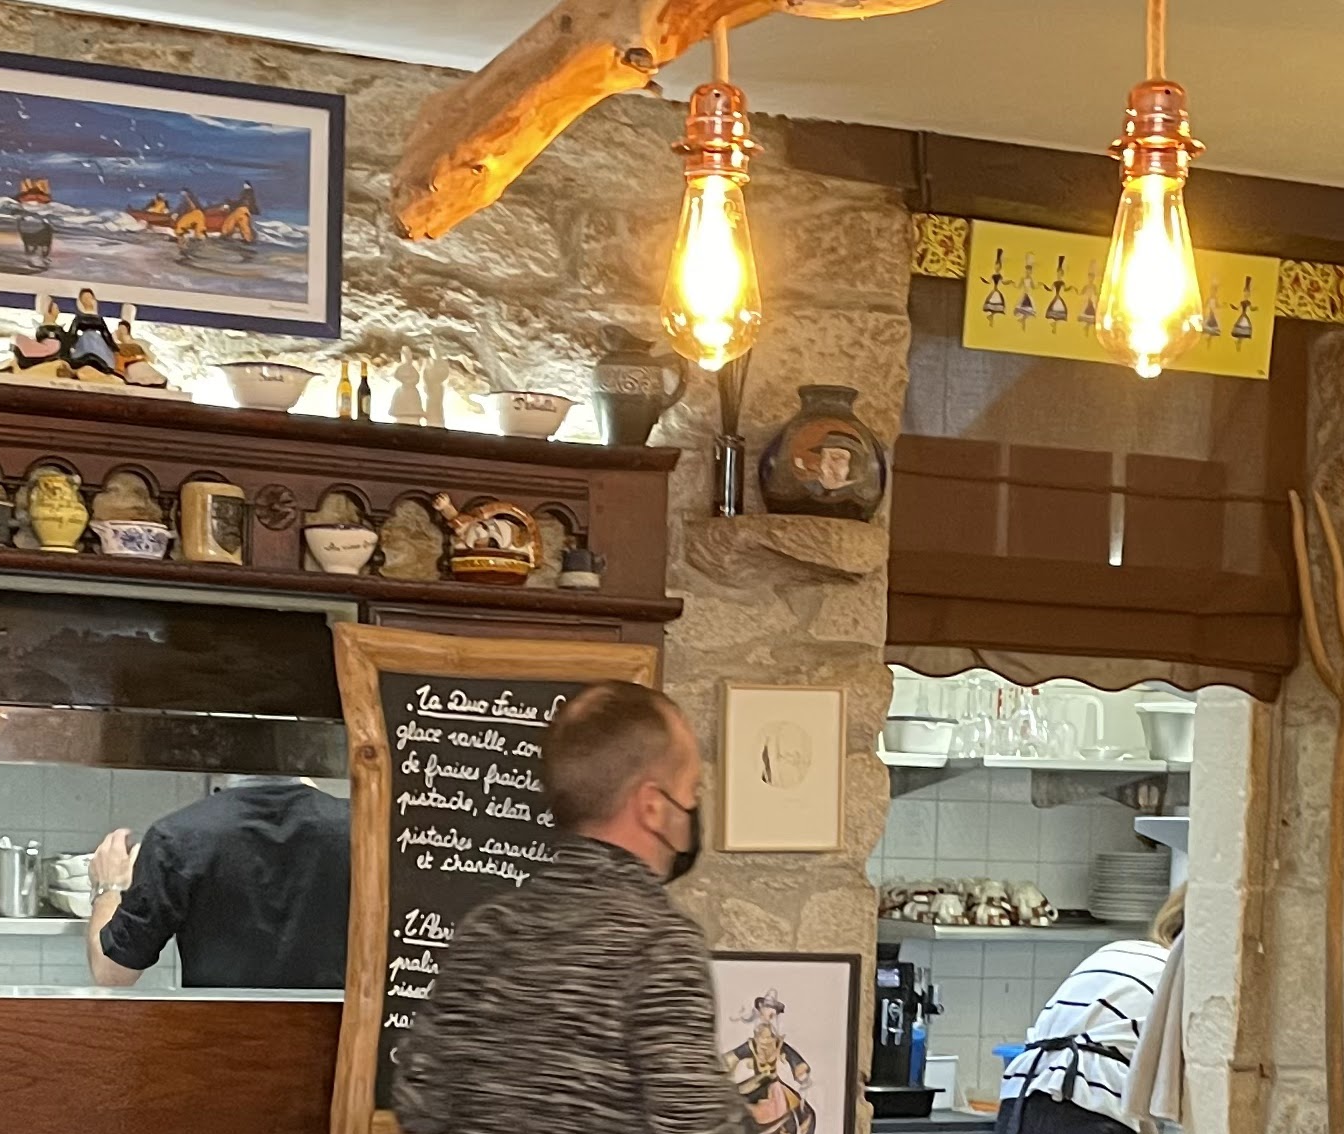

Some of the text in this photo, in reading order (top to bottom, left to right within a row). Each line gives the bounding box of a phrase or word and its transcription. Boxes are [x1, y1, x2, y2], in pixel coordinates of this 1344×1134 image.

[415, 684, 443, 711] La
[447, 689, 490, 714] Duo
[396, 720, 443, 750] glace
[401, 750, 420, 774] de
[424, 753, 480, 789] fraises
[397, 787, 478, 816] pistache,
[536, 808, 556, 828] de
[396, 825, 473, 853] pistaches
[416, 851, 434, 870] et
[389, 950, 439, 982] pralin
